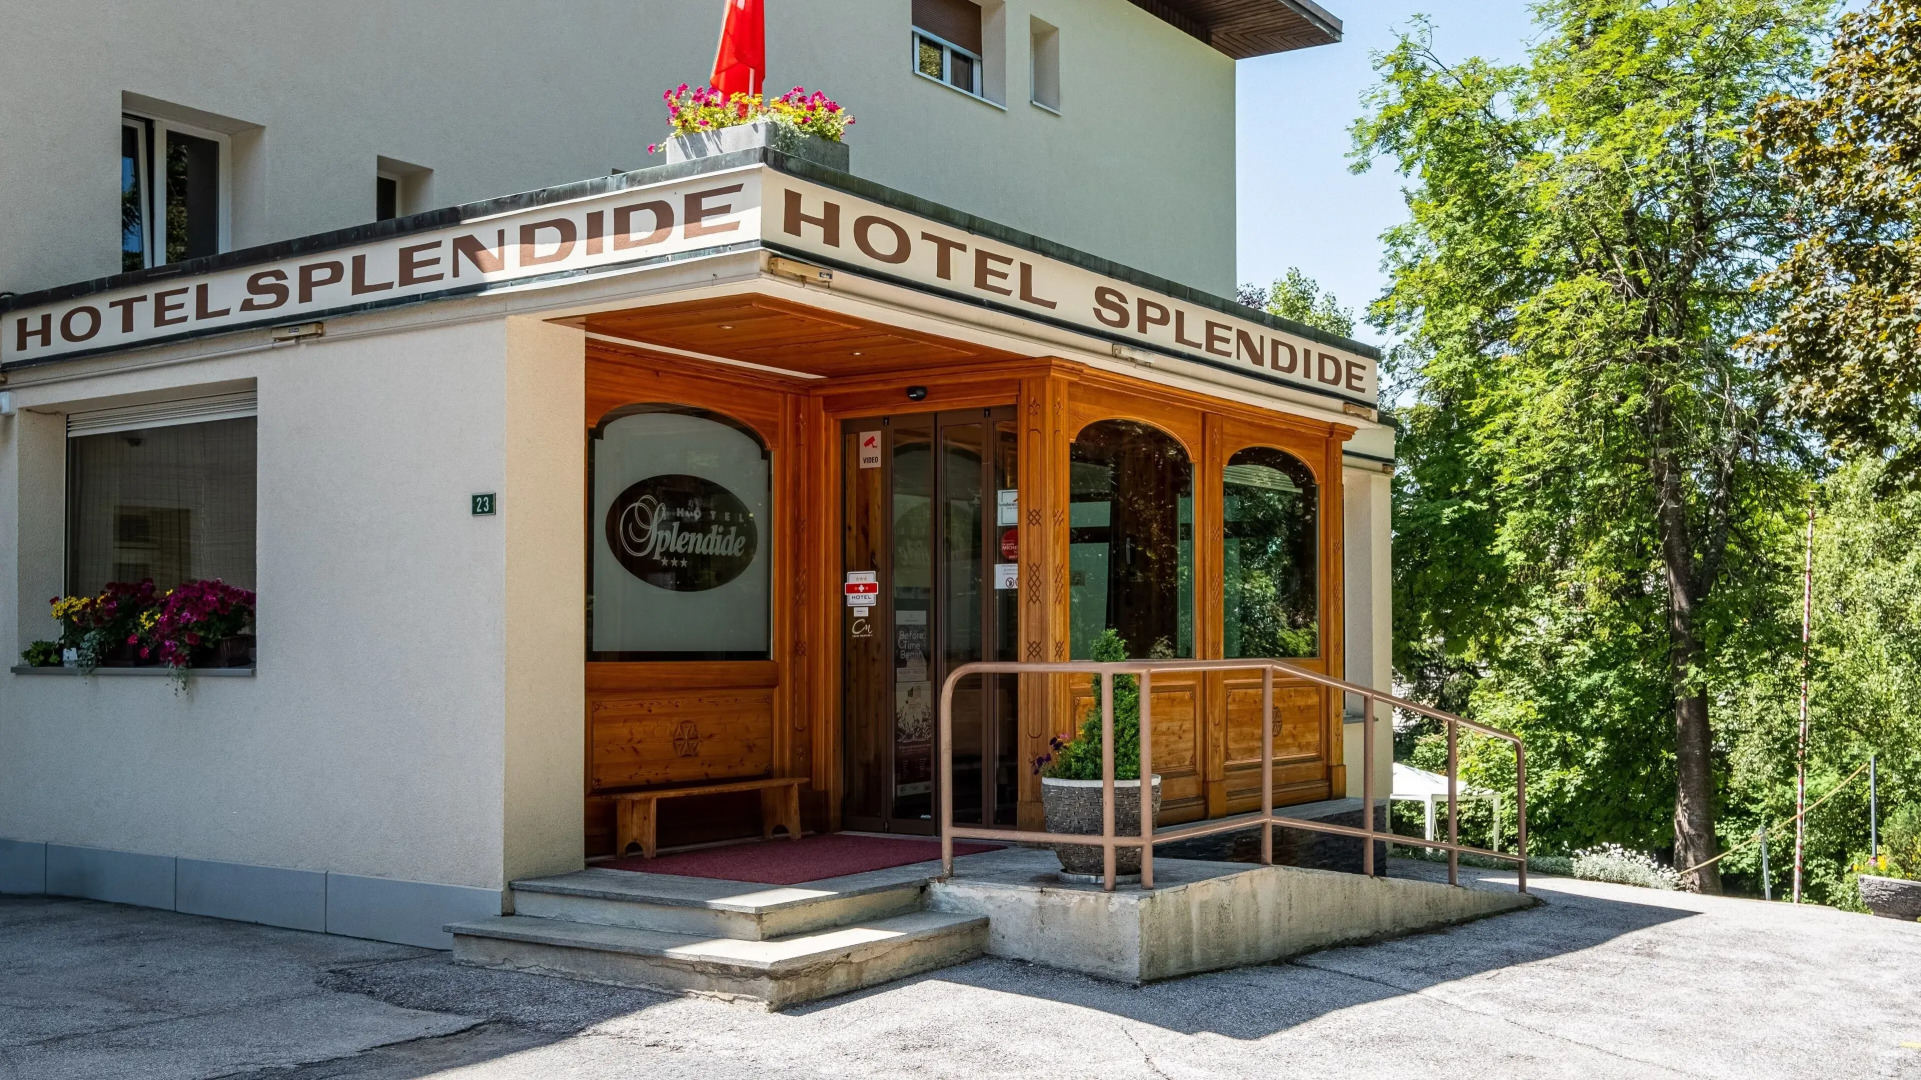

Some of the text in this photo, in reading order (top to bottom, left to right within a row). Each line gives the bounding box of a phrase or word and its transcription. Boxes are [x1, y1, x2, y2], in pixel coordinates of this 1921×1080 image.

[16, 183, 744, 351] HOTEL SPLENDIDE
[783, 189, 1367, 393] HOTEL SPLENDIDE
[863, 456, 879, 464] VIDEO
[476, 496, 489, 512] 23
[676, 507, 745, 522] HOTEL
[619, 494, 746, 561] Splendide
